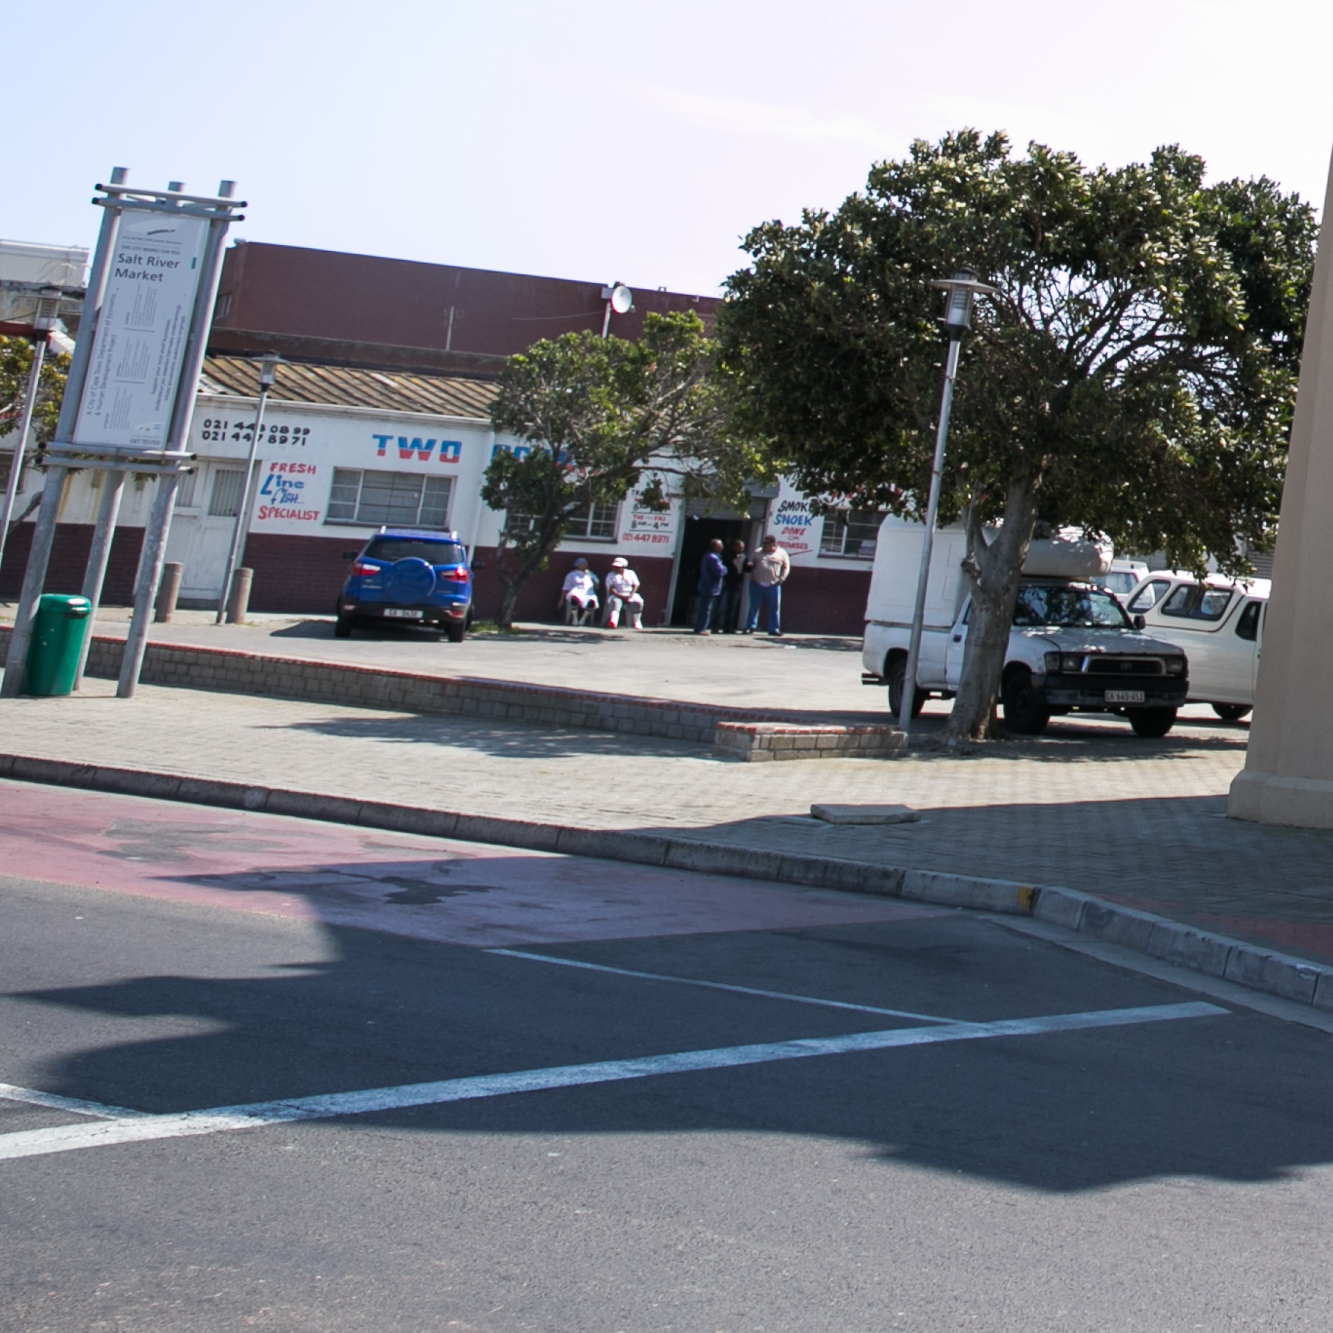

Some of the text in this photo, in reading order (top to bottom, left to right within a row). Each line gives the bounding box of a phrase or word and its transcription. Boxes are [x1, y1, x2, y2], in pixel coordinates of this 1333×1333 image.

[117, 252, 180, 269] Salt River
[114, 267, 164, 282] Market
[204, 419, 228, 430] 021
[202, 430, 226, 441] 021
[371, 433, 463, 464] TWO
[270, 462, 317, 474] FRESH
[260, 473, 304, 495] Line
[257, 505, 321, 521] SPECIALIST
[778, 500, 810, 513] SMOK
[773, 513, 813, 526] SNOEK
[781, 526, 807, 536] DONE
